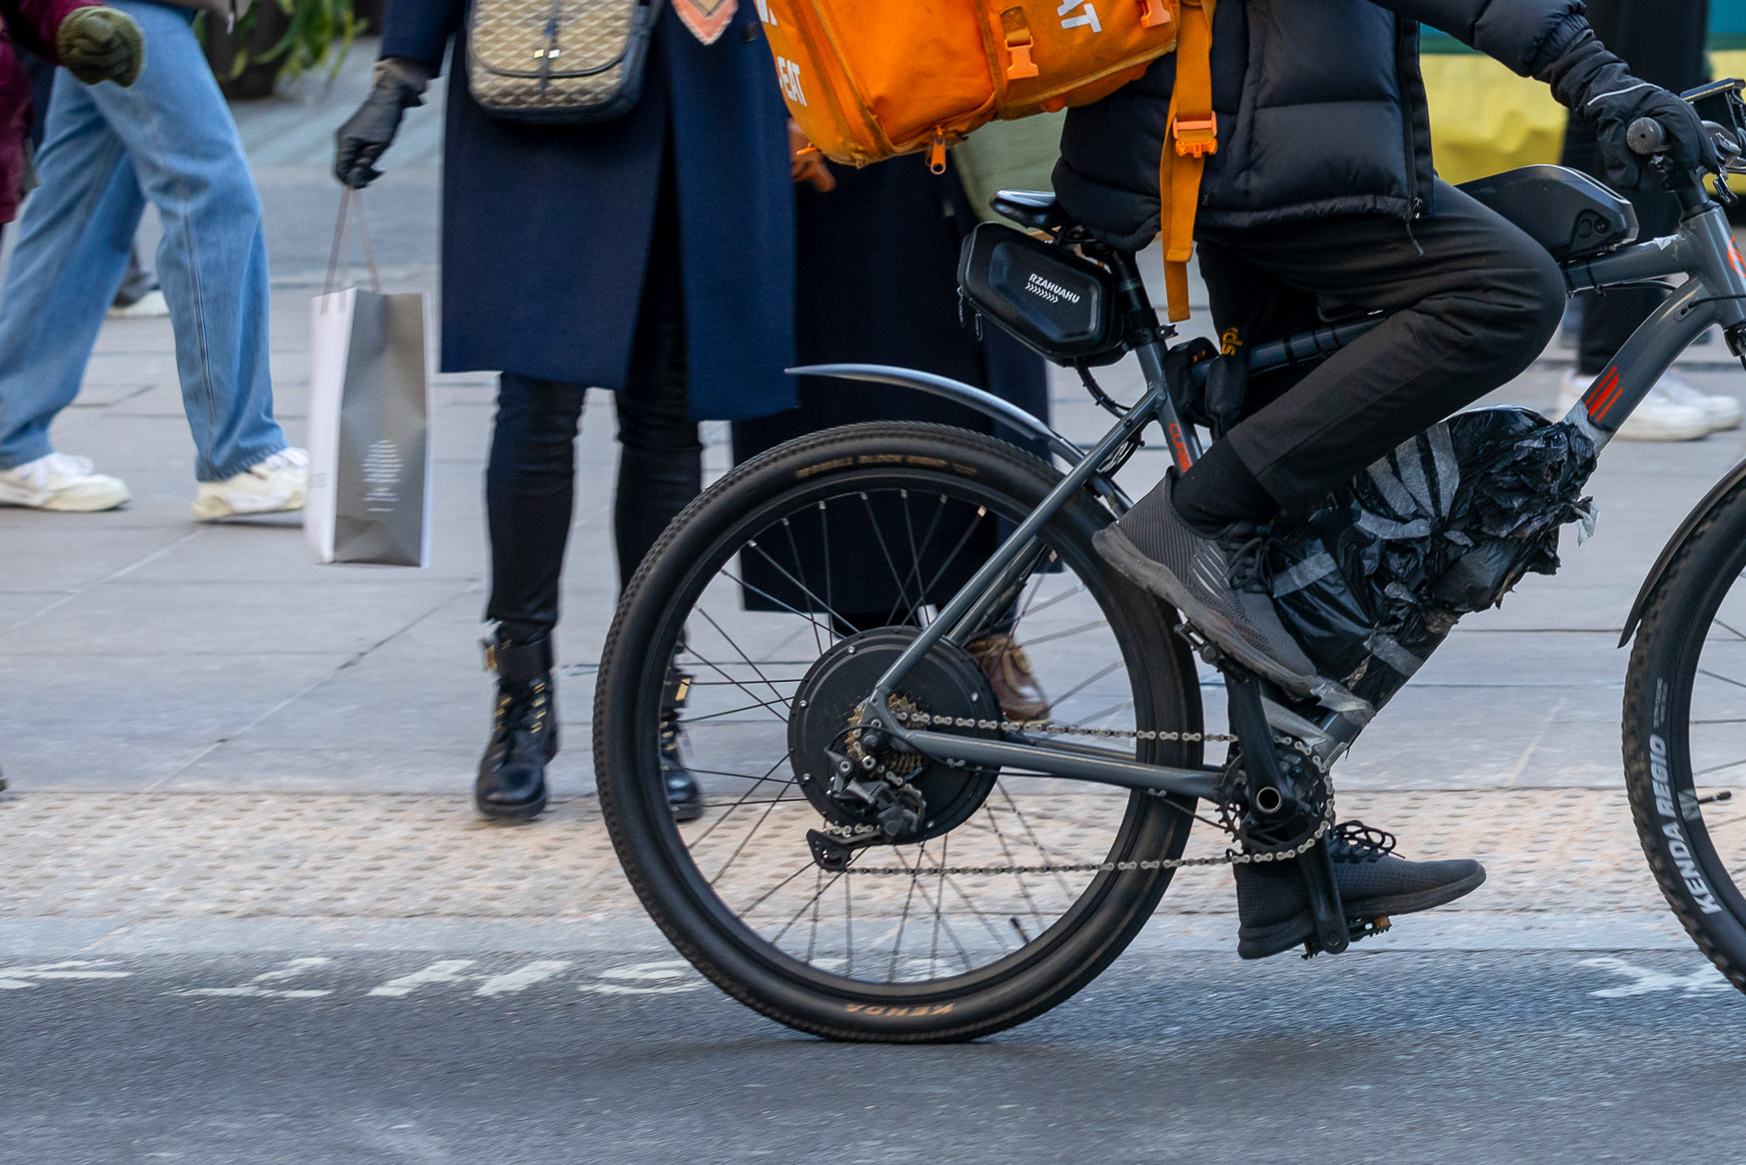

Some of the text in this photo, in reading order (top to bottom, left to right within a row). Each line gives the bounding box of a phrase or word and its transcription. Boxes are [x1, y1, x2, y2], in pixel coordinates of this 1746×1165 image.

[777, 55, 808, 107] EAT
[1028, 272, 1080, 304] RZAHUAHU
[1650, 733, 1723, 915] KENDA REGIO
[845, 1002, 956, 1017] KENDA
